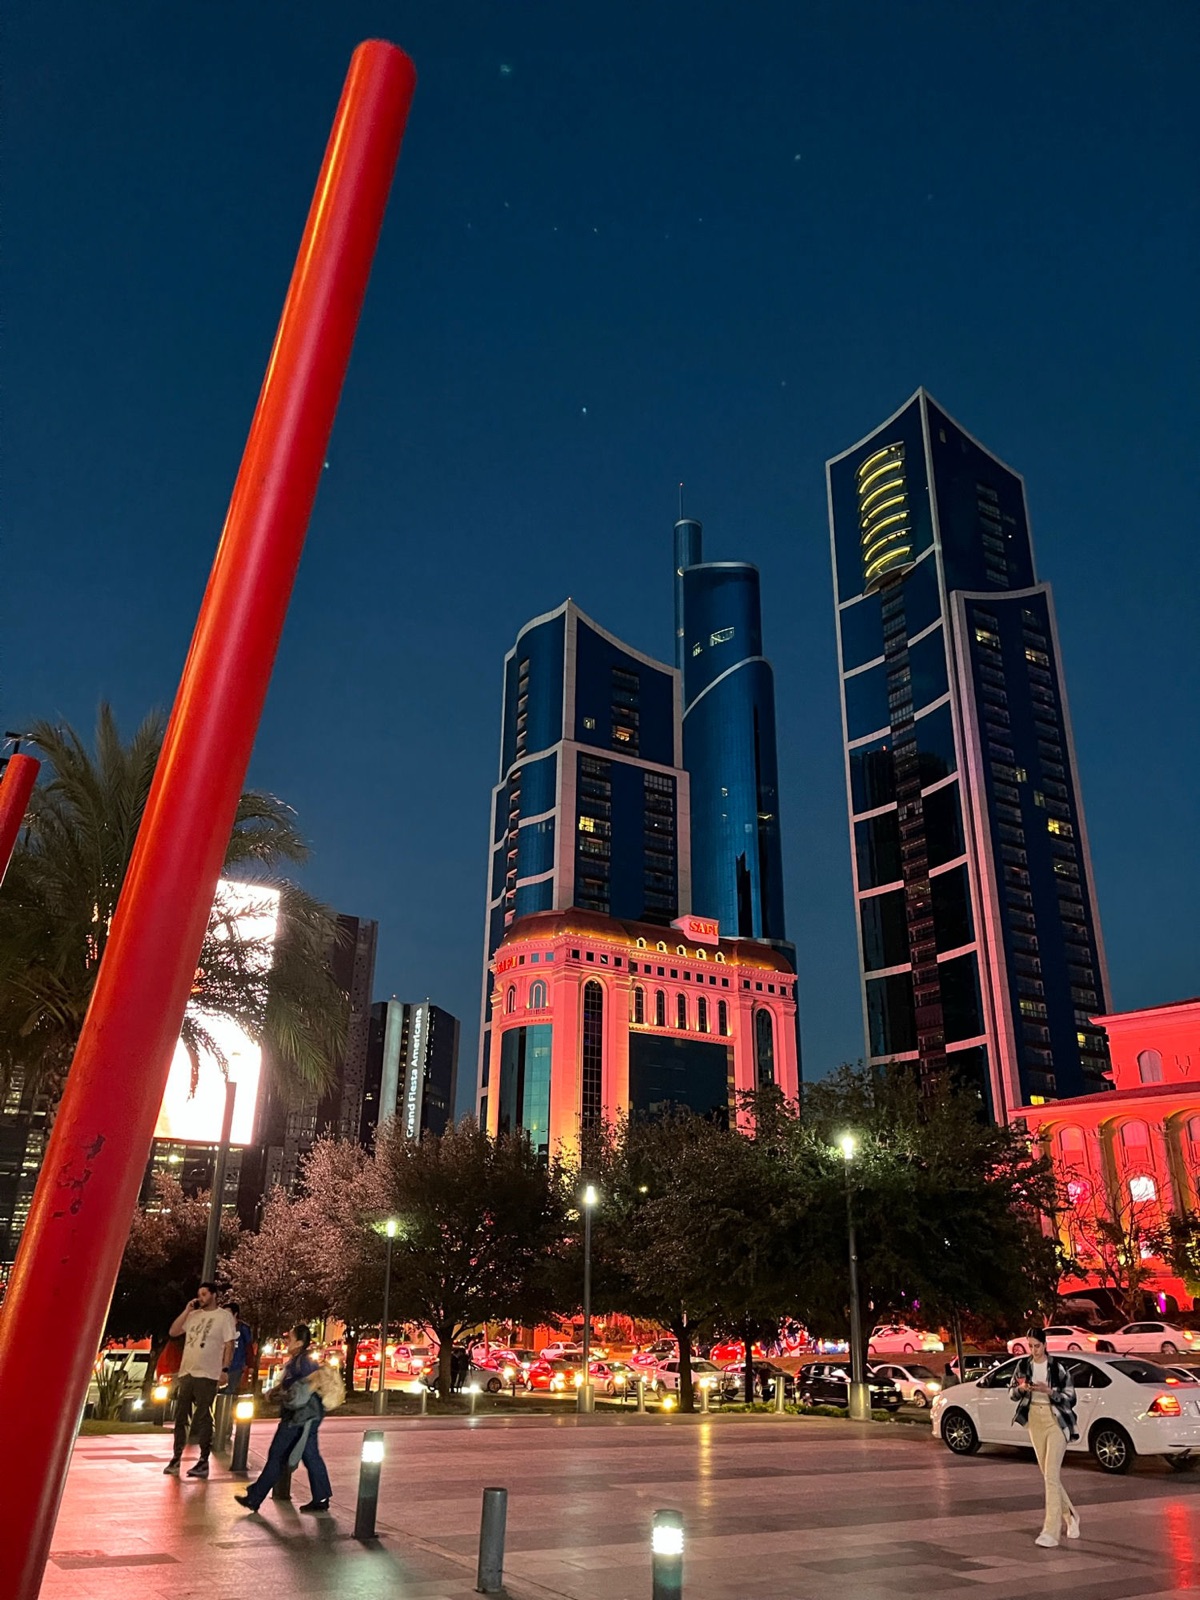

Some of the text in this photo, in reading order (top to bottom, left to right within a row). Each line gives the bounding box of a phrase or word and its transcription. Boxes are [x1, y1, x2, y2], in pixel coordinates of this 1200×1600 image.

[689, 920, 719, 936] SAFI
[406, 1007, 423, 1138] Grand Fiesta Americana
